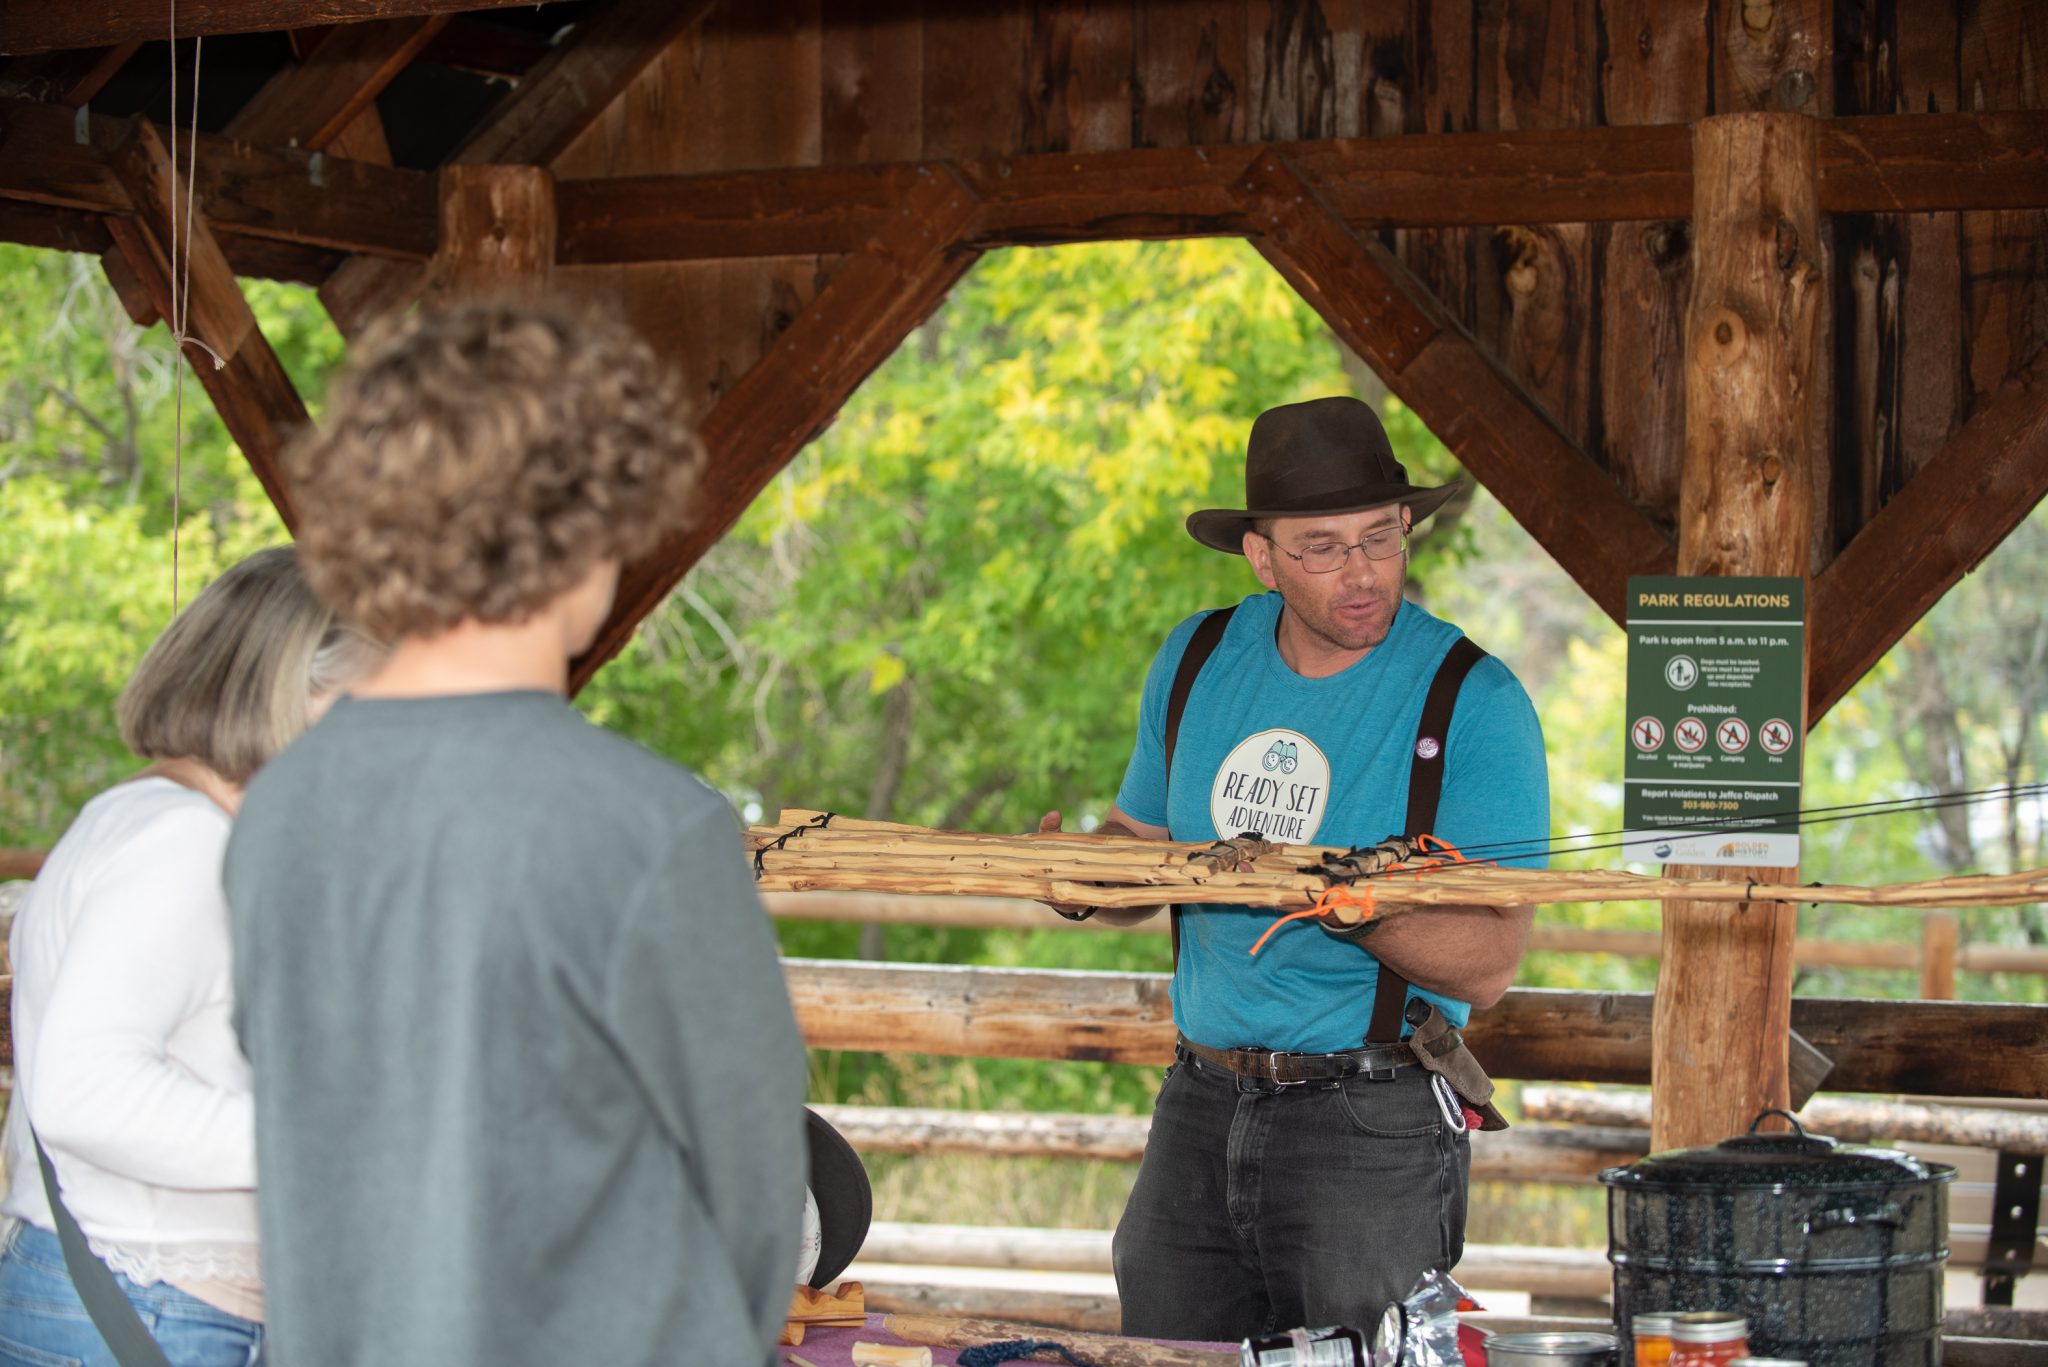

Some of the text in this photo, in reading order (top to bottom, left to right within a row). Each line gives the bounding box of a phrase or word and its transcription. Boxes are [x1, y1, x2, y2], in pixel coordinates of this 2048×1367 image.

[1639, 593, 1791, 608] PARK REGULATIONS
[1639, 634, 1790, 647] Park is open from 5 a.m. to 11 p.m.
[1687, 704, 1737, 715] Prohibited:
[1222, 772, 1320, 815] READY SET
[1641, 788, 1779, 802] Report violations to Jeffco Dispatch
[1226, 806, 1306, 839] ADVENTURE
